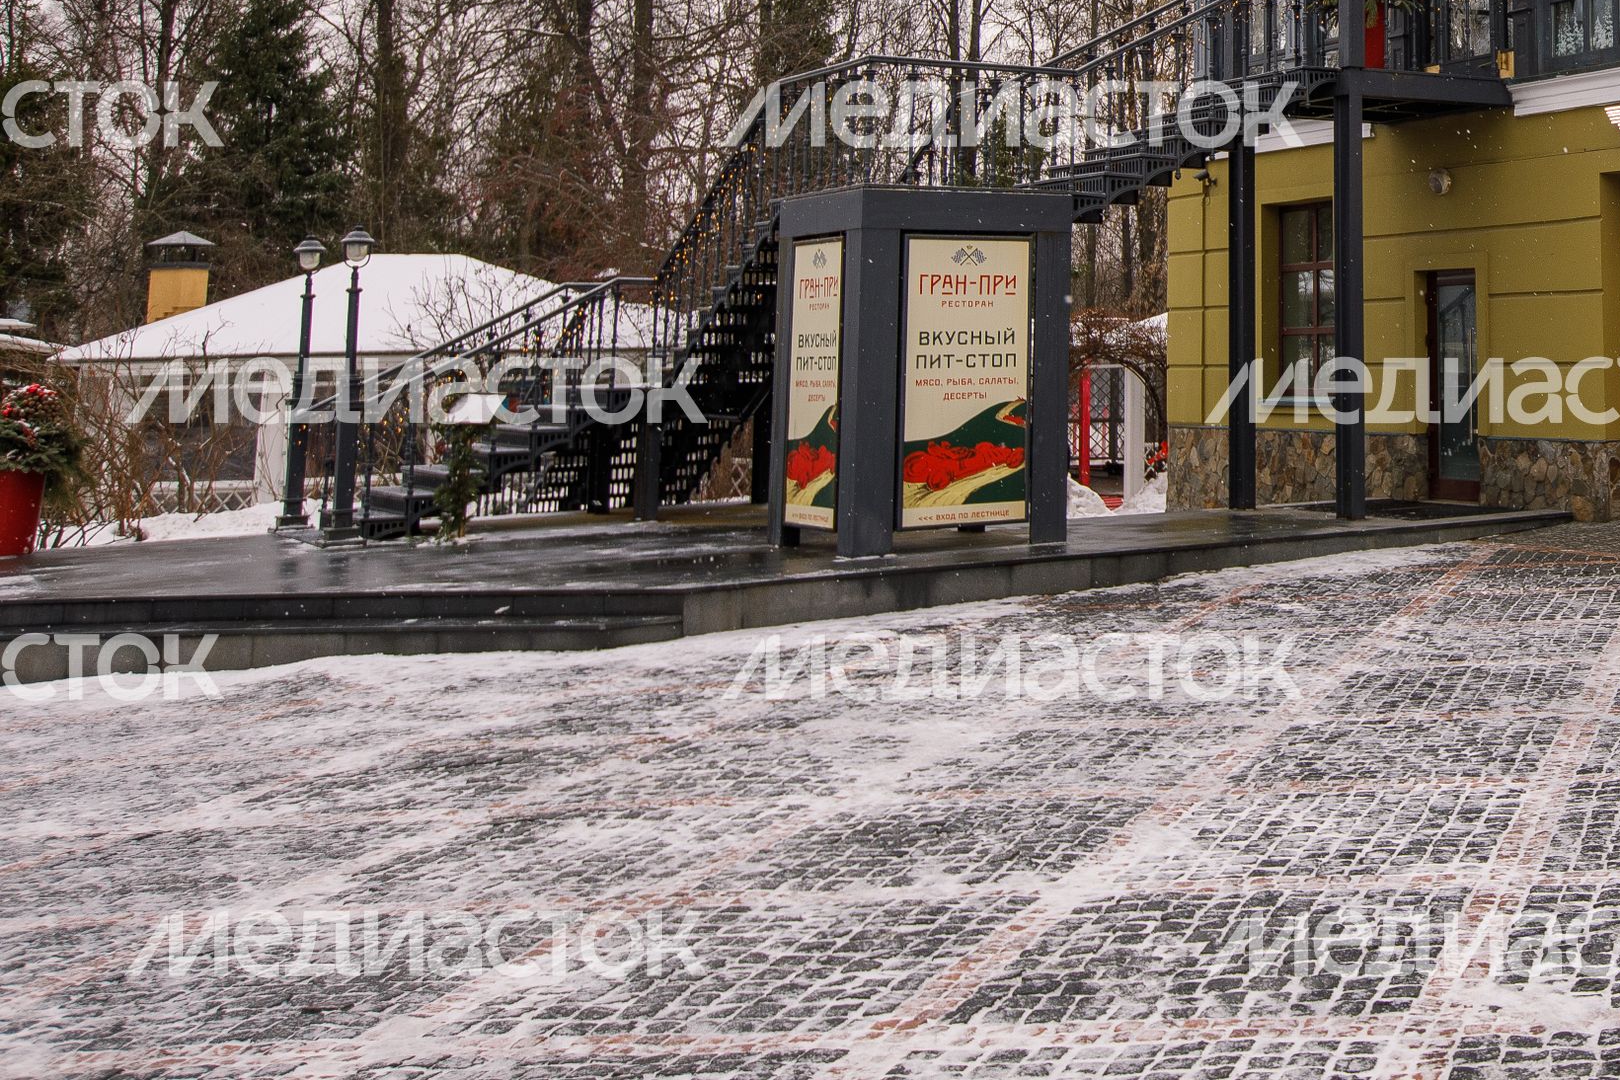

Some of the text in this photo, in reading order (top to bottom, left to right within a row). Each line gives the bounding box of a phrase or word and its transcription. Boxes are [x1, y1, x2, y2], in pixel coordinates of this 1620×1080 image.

[799, 276, 839, 300] ГРАН-ПРИ
[919, 274, 1017, 295] ГРАН-ПРИ
[941, 300, 994, 308] РЕСТОРАН
[798, 329, 837, 348] ВКУСНЫЙ
[919, 327, 1015, 346] ВКУСНЫЙ
[796, 356, 837, 371] ПИТ-СТОП
[915, 353, 1017, 369] ПИТ-СТОП
[915, 376, 1019, 387] МЯСО, РЫБА, САЛАТЫ,
[943, 392, 987, 401] ДЕСЕРТЫ
[936, 512, 956, 521] ВХОД
[971, 510, 1010, 519] ЛЕСТНИЦЕ
